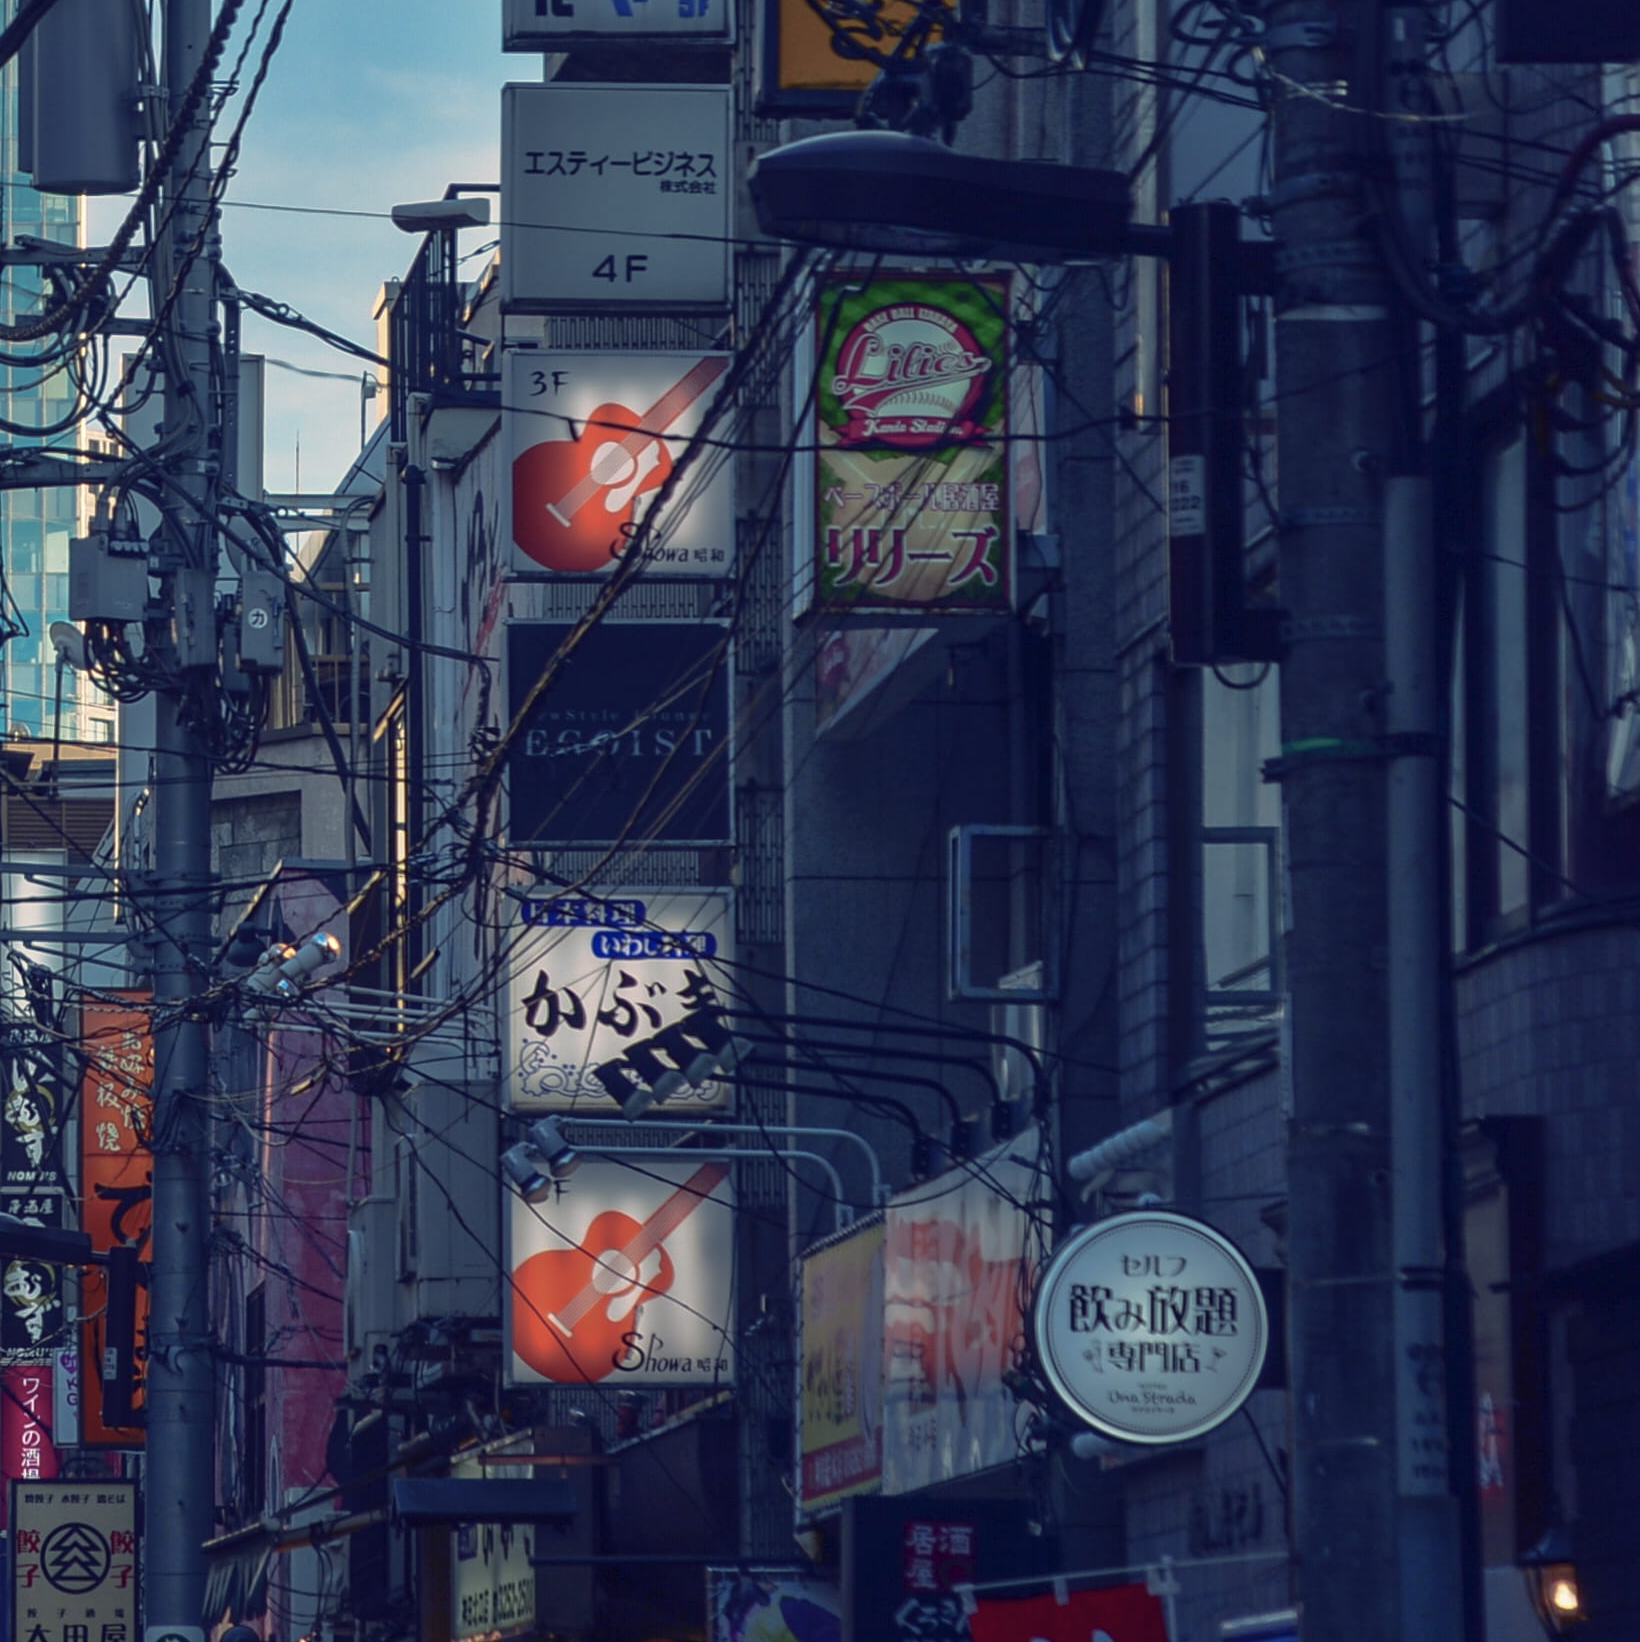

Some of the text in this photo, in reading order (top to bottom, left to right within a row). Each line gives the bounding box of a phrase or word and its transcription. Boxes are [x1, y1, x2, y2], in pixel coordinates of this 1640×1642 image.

[524, 151, 717, 177] エスティービジネス
[659, 180, 717, 196] 株式会社
[592, 255, 649, 282] 4F
[833, 333, 992, 399] Lilies
[530, 371, 569, 396] 3F
[824, 481, 1000, 512] ベースボール居酒屋
[825, 525, 1000, 587] リリーズ
[525, 728, 713, 757] EGOIST
[529, 901, 637, 925] 日本料理
[1122, 1255, 1187, 1278] セルフ
[1069, 1284, 1238, 1337] 飲み放題
[1107, 1340, 1201, 1373] 専門店
[16, 1529, 41, 1588] 餃子
[110, 1530, 135, 1589] 餃子
